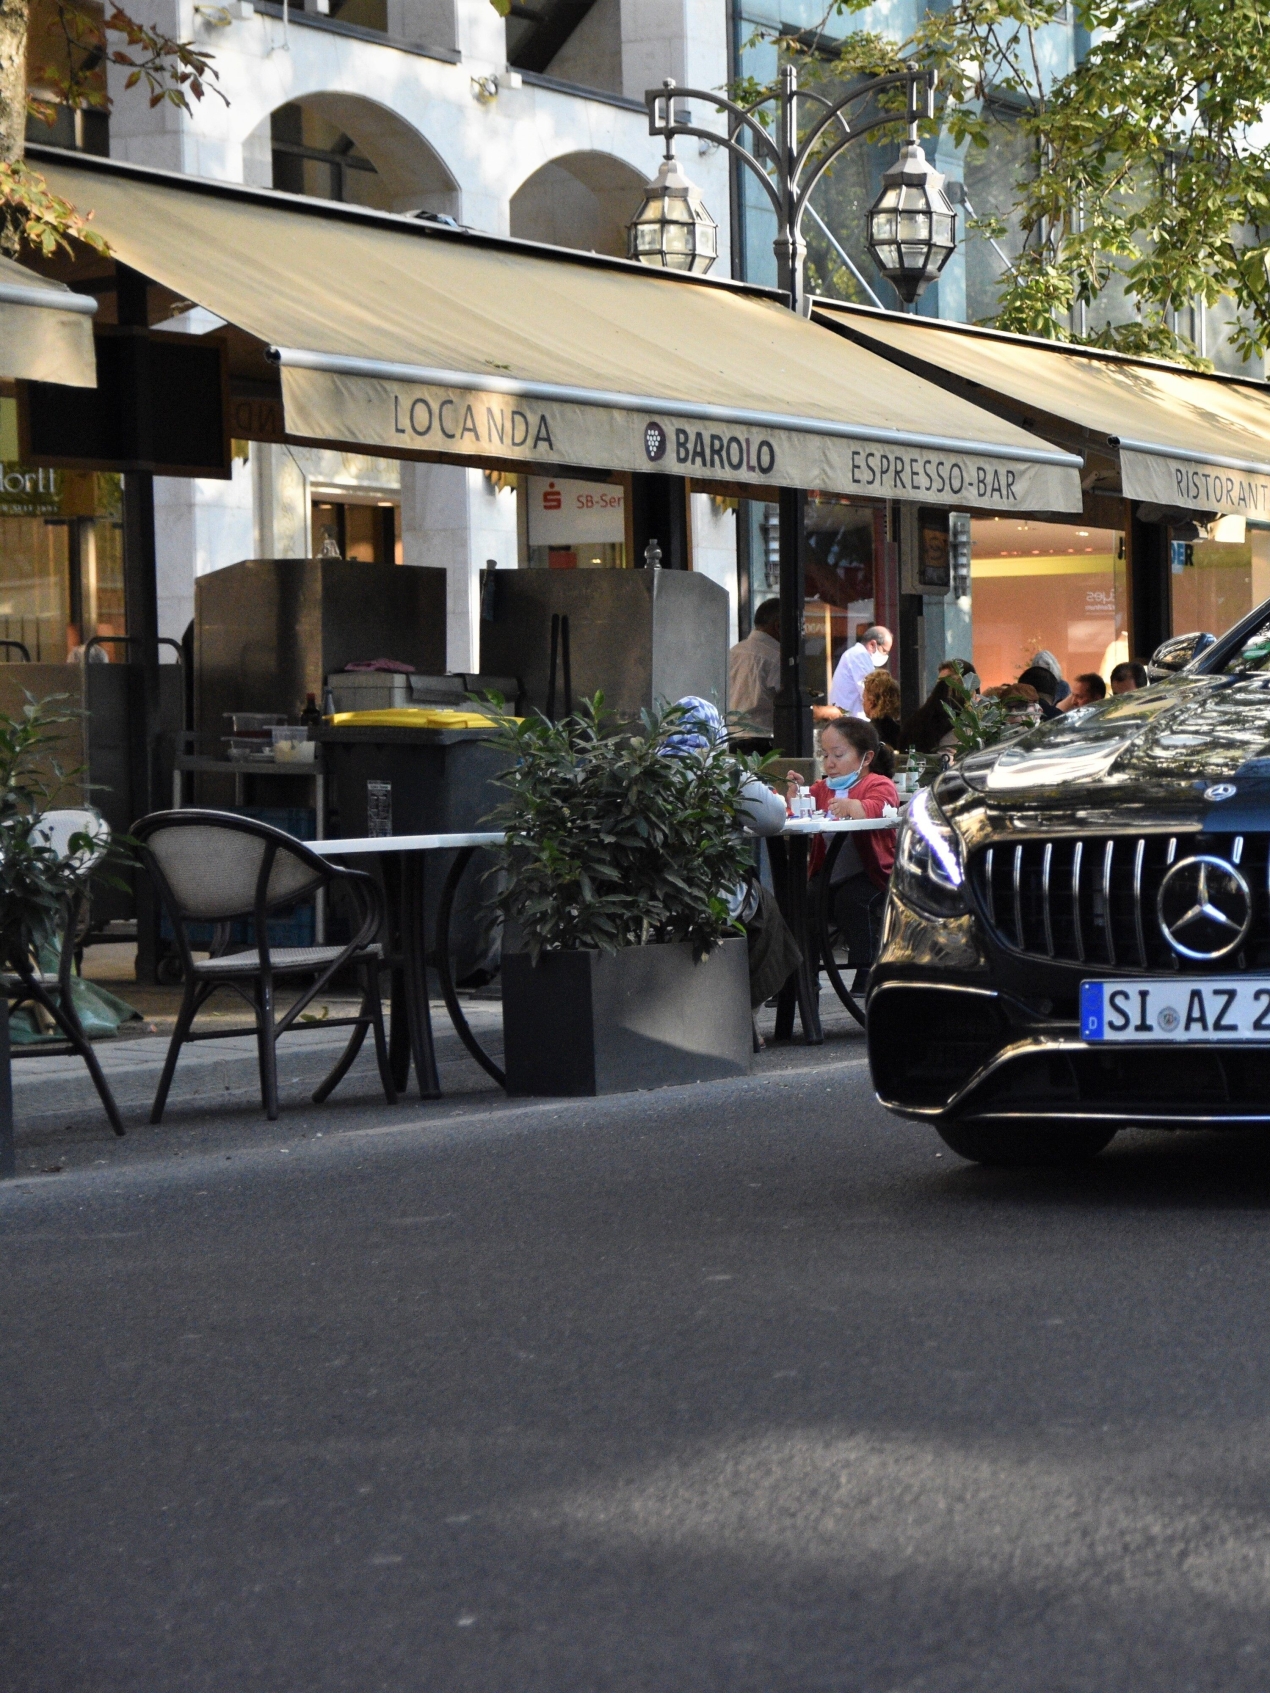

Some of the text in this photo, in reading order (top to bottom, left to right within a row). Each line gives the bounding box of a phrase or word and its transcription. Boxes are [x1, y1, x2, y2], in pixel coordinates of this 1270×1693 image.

[394, 395, 554, 451] LOCANDA
[675, 427, 776, 475] BAROLO
[851, 451, 1017, 501] ESPRESSO-BAR
[1107, 989, 1154, 1032] SI
[1184, 988, 1239, 1032] AZ
